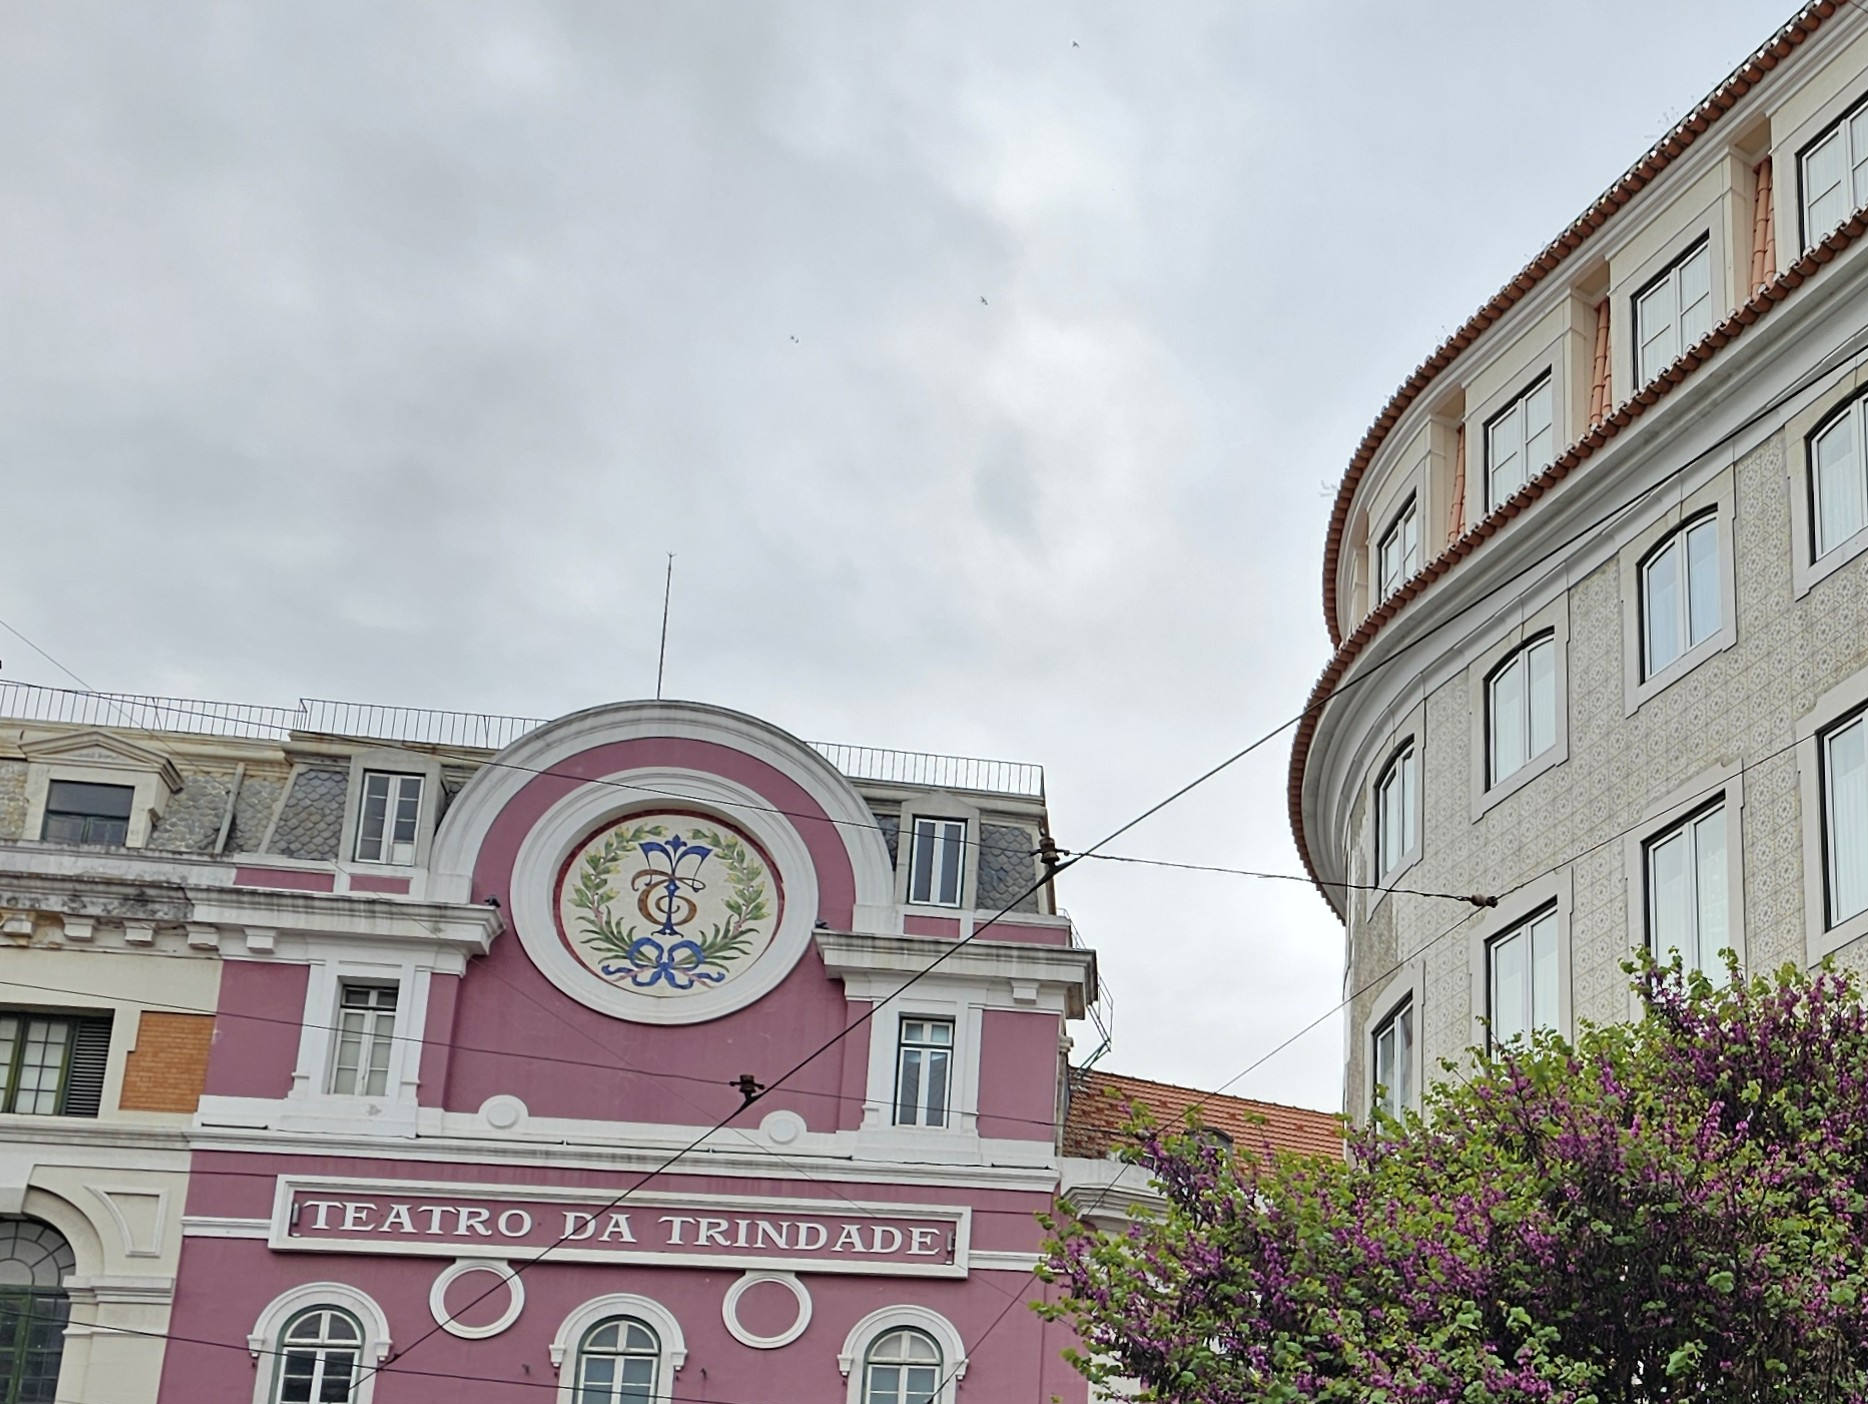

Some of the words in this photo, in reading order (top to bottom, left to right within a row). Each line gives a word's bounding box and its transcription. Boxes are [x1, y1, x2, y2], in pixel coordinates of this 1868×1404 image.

[304, 1199, 534, 1240] TEATRO
[561, 1210, 638, 1245] DA
[658, 1214, 942, 1257] TRINDADE
